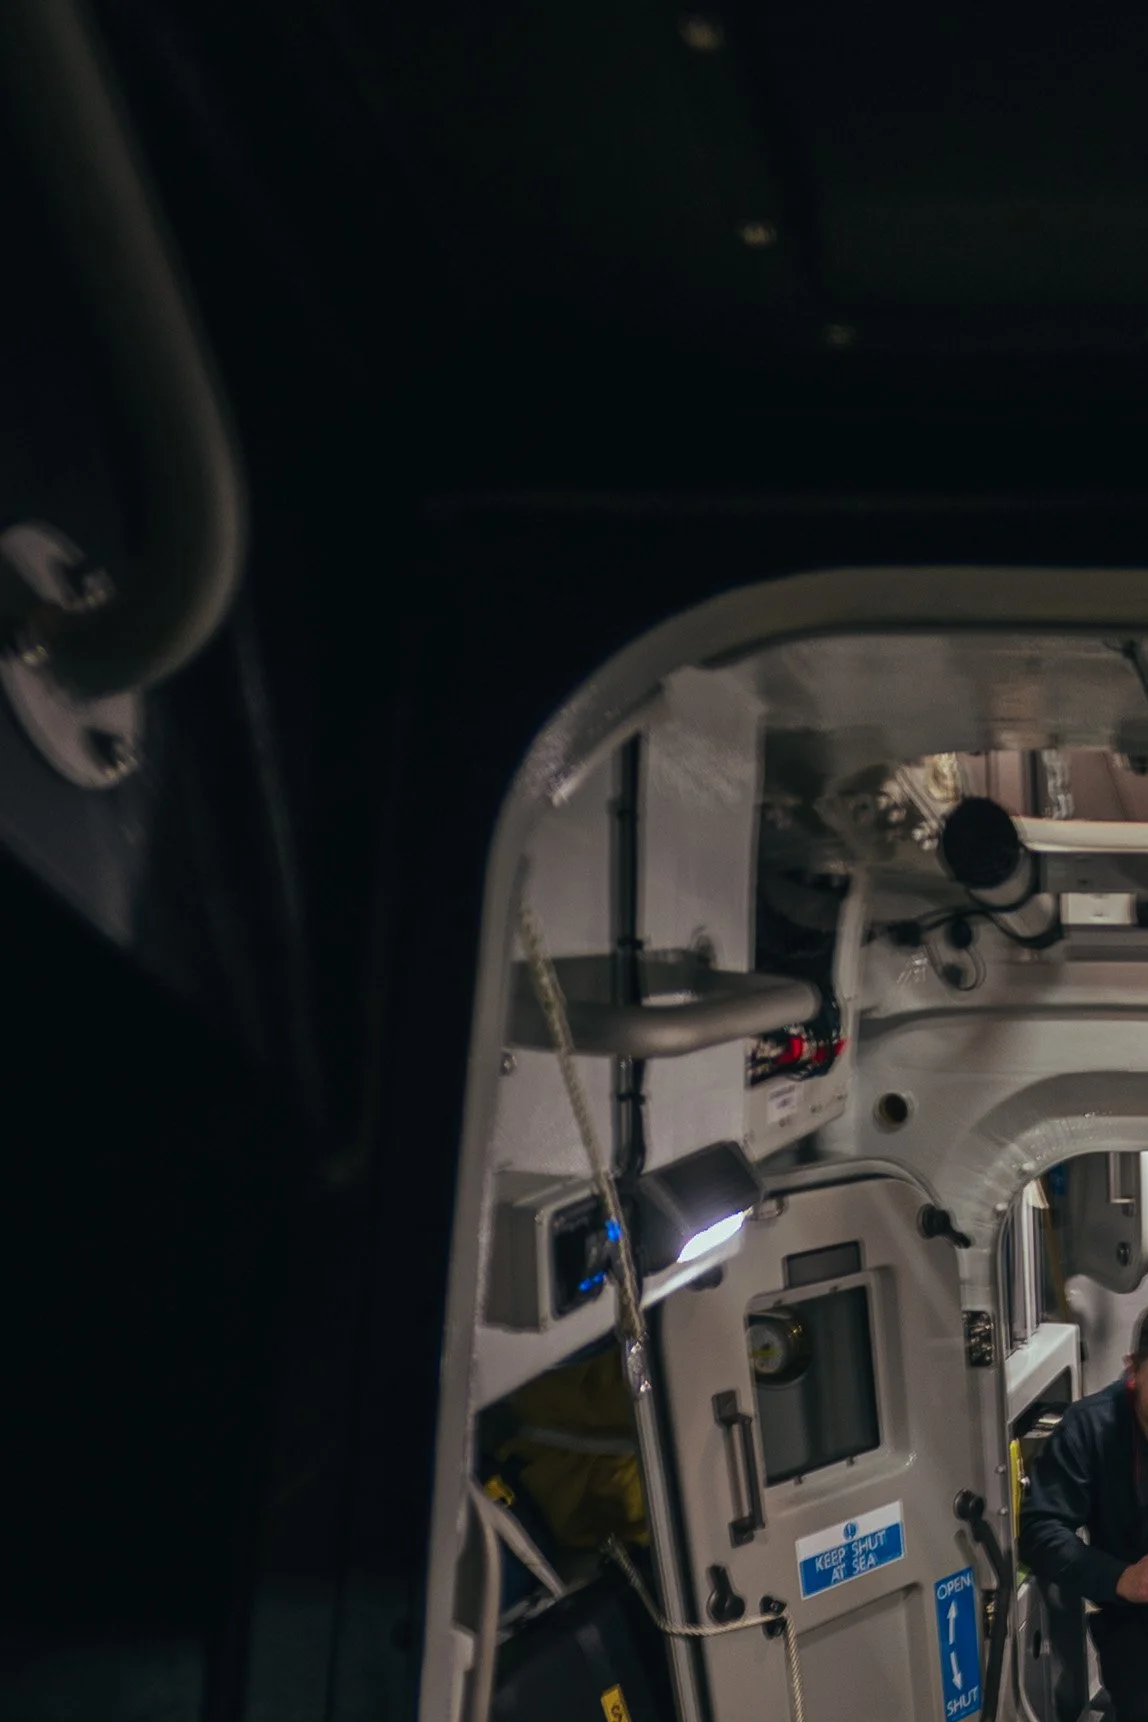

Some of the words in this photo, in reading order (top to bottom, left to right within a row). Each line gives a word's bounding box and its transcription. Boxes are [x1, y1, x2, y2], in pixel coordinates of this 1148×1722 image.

[815, 1547, 846, 1573] KEEP
[851, 1530, 887, 1558] SHUT
[830, 1563, 847, 1585] AT
[852, 1553, 877, 1575] SEA
[936, 1573, 971, 1600] OPEN
[946, 1685, 979, 1716] SHUT
